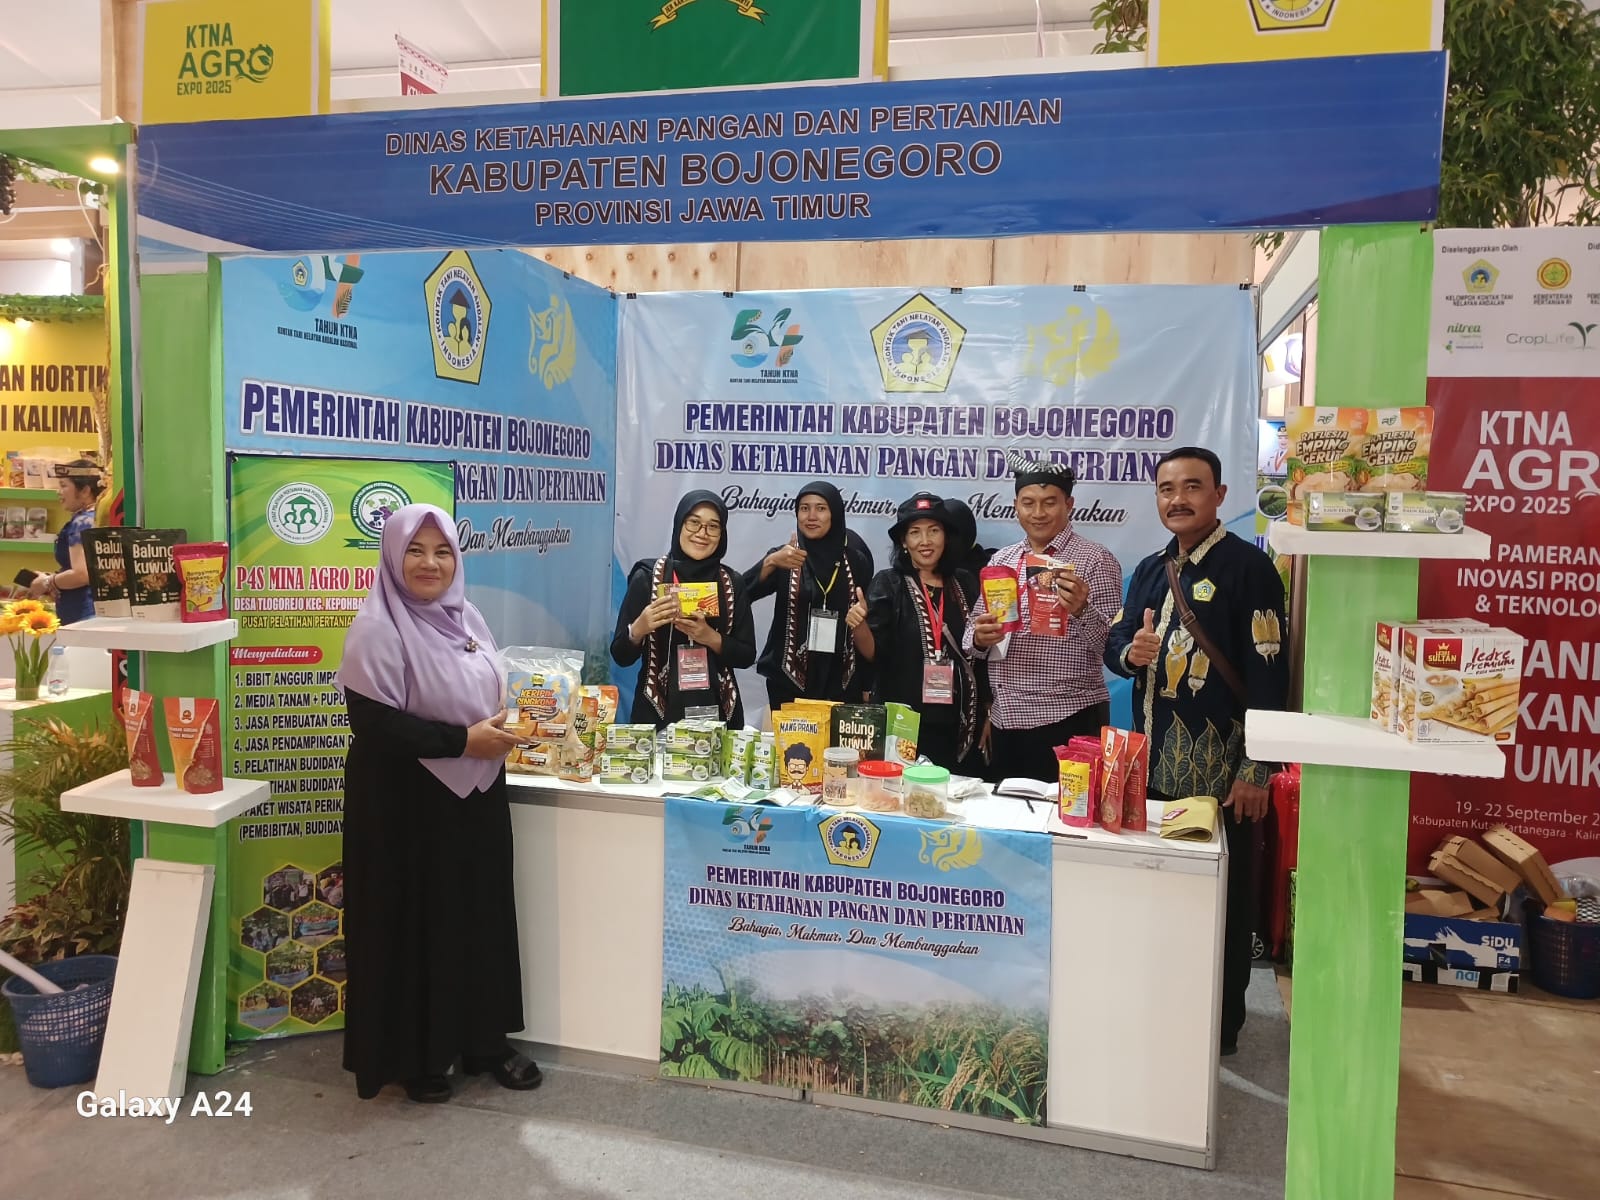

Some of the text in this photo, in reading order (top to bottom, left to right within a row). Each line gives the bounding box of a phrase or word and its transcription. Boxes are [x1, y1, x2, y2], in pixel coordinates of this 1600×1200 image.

[186, 22, 233, 48] KTNA
[178, 44, 274, 80] AGRO
[177, 80, 232, 96] EXPO 2025
[385, 98, 1062, 156] DINAS KETAHANAN PANGAN DAN PERTANIAN
[429, 139, 1002, 196] KABUPATEN BOJONEGORO
[535, 192, 872, 227] PROVINSI JAWA TIMUR
[1441, 244, 1519, 254] Diselenggarakan Oleh
[441, 271, 453, 288] TANI
[314, 317, 338, 336] TAHUN
[909, 313, 942, 328] NELAYAN
[1447, 322, 1481, 333] nitrea
[1506, 333, 1575, 345] CropLife
[441, 340, 477, 368] INDONESIA
[243, 382, 592, 460] PEMERINTAH KABUPATEN BOJONEGORO
[686, 403, 1175, 438] PEMERINTAH KABUPATEN BOJONEGORO
[1479, 410, 1573, 446] KTNA
[1301, 430, 1349, 442] RAFLESIA
[1296, 439, 1350, 456] EMPING
[1361, 439, 1417, 459] EMPING
[655, 442, 723, 471] DINAS
[731, 444, 869, 475] KETAHANAN
[877, 447, 978, 479] PANGAN
[1050, 450, 1166, 482] PERTAN
[1366, 451, 1414, 467] GERUT
[455, 462, 606, 502] NGAN DAN PERTANIAN
[721, 485, 797, 517] Bahagia
[838, 488, 898, 515] akmur,
[1465, 495, 1571, 515] EXPO 2025
[456, 516, 571, 555] Dan Membanggakan
[1497, 544, 1600, 566] PAMERAN
[133, 558, 176, 574] kuwuk
[236, 566, 265, 590] P4S
[269, 566, 305, 590] MINA
[309, 566, 350, 590] AGRO
[354, 567, 376, 590] BO
[1457, 568, 1600, 592] INOVASI PRO
[234, 597, 257, 611] DESA
[257, 597, 305, 612] TLOGOREJO
[305, 597, 325, 611] KEC.
[1475, 594, 1491, 613] &
[242, 615, 355, 628] PUSAT PELATIHAN PERTANIA
[232, 647, 309, 663] Menyediakan
[235, 673, 243, 687] 1.
[246, 673, 271, 686] BIBIT
[274, 672, 314, 685] ANGGUR
[234, 695, 243, 708] 2.
[246, 694, 275, 708] MEDIA
[278, 694, 311, 707] TANAM
[321, 693, 348, 706] PUPU
[234, 714, 350, 730] 3. JASA PEMBUATAN GRE
[838, 719, 875, 737] Balung
[234, 739, 242, 752] 4.
[245, 738, 270, 752] JASA
[272, 735, 345, 751] PENDAMPINGAN
[838, 735, 873, 751] kuwuk
[233, 756, 345, 774] 5. PELATIHAN BUDIDAYA
[300, 778, 345, 792] BUDIDAYA
[278, 800, 312, 815] WISATA
[315, 799, 344, 813] PERIK
[1456, 801, 1472, 814] 19
[1485, 803, 1501, 817] 22
[1506, 804, 1588, 825] September
[240, 822, 303, 842] (PEMBIBITAN,
[1412, 815, 1469, 830] Kabupaten
[707, 865, 1005, 908] PEMERINTAH KABUPATEN BOJONEGORO
[689, 887, 1024, 935] DINAS KETAHANAN PANGAN DAN PERTANIAN
[728, 916, 979, 957] Bahagia, Makmur, Dan Membanggakan
[1481, 935, 1514, 948] SiDU
[1498, 956, 1511, 964] F4
